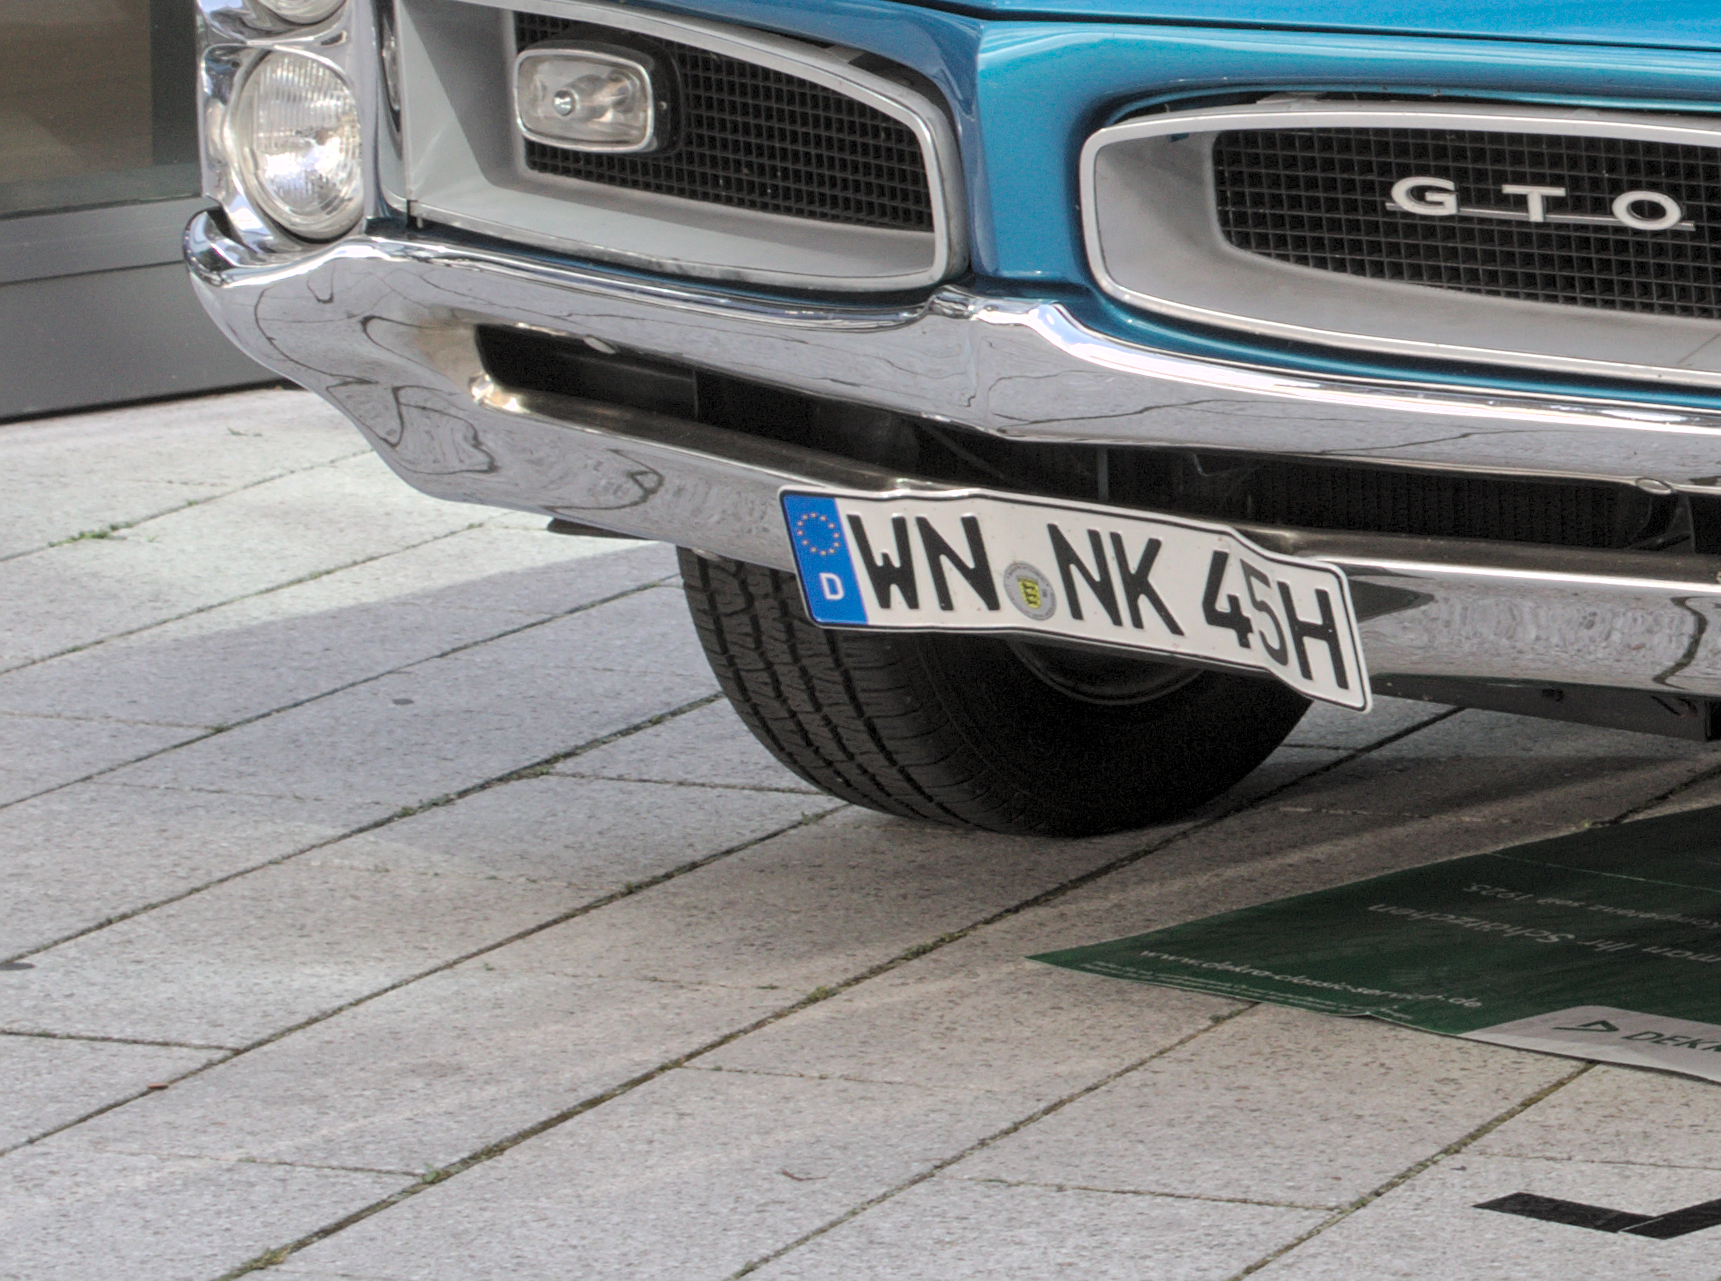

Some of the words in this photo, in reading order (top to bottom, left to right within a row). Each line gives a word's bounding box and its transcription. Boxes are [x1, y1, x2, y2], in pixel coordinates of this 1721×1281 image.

[1391, 176, 1683, 231] GTO
[819, 572, 844, 601] D
[846, 514, 1001, 612] WN
[1046, 522, 1186, 636] NK
[1202, 549, 1350, 690] 45H
